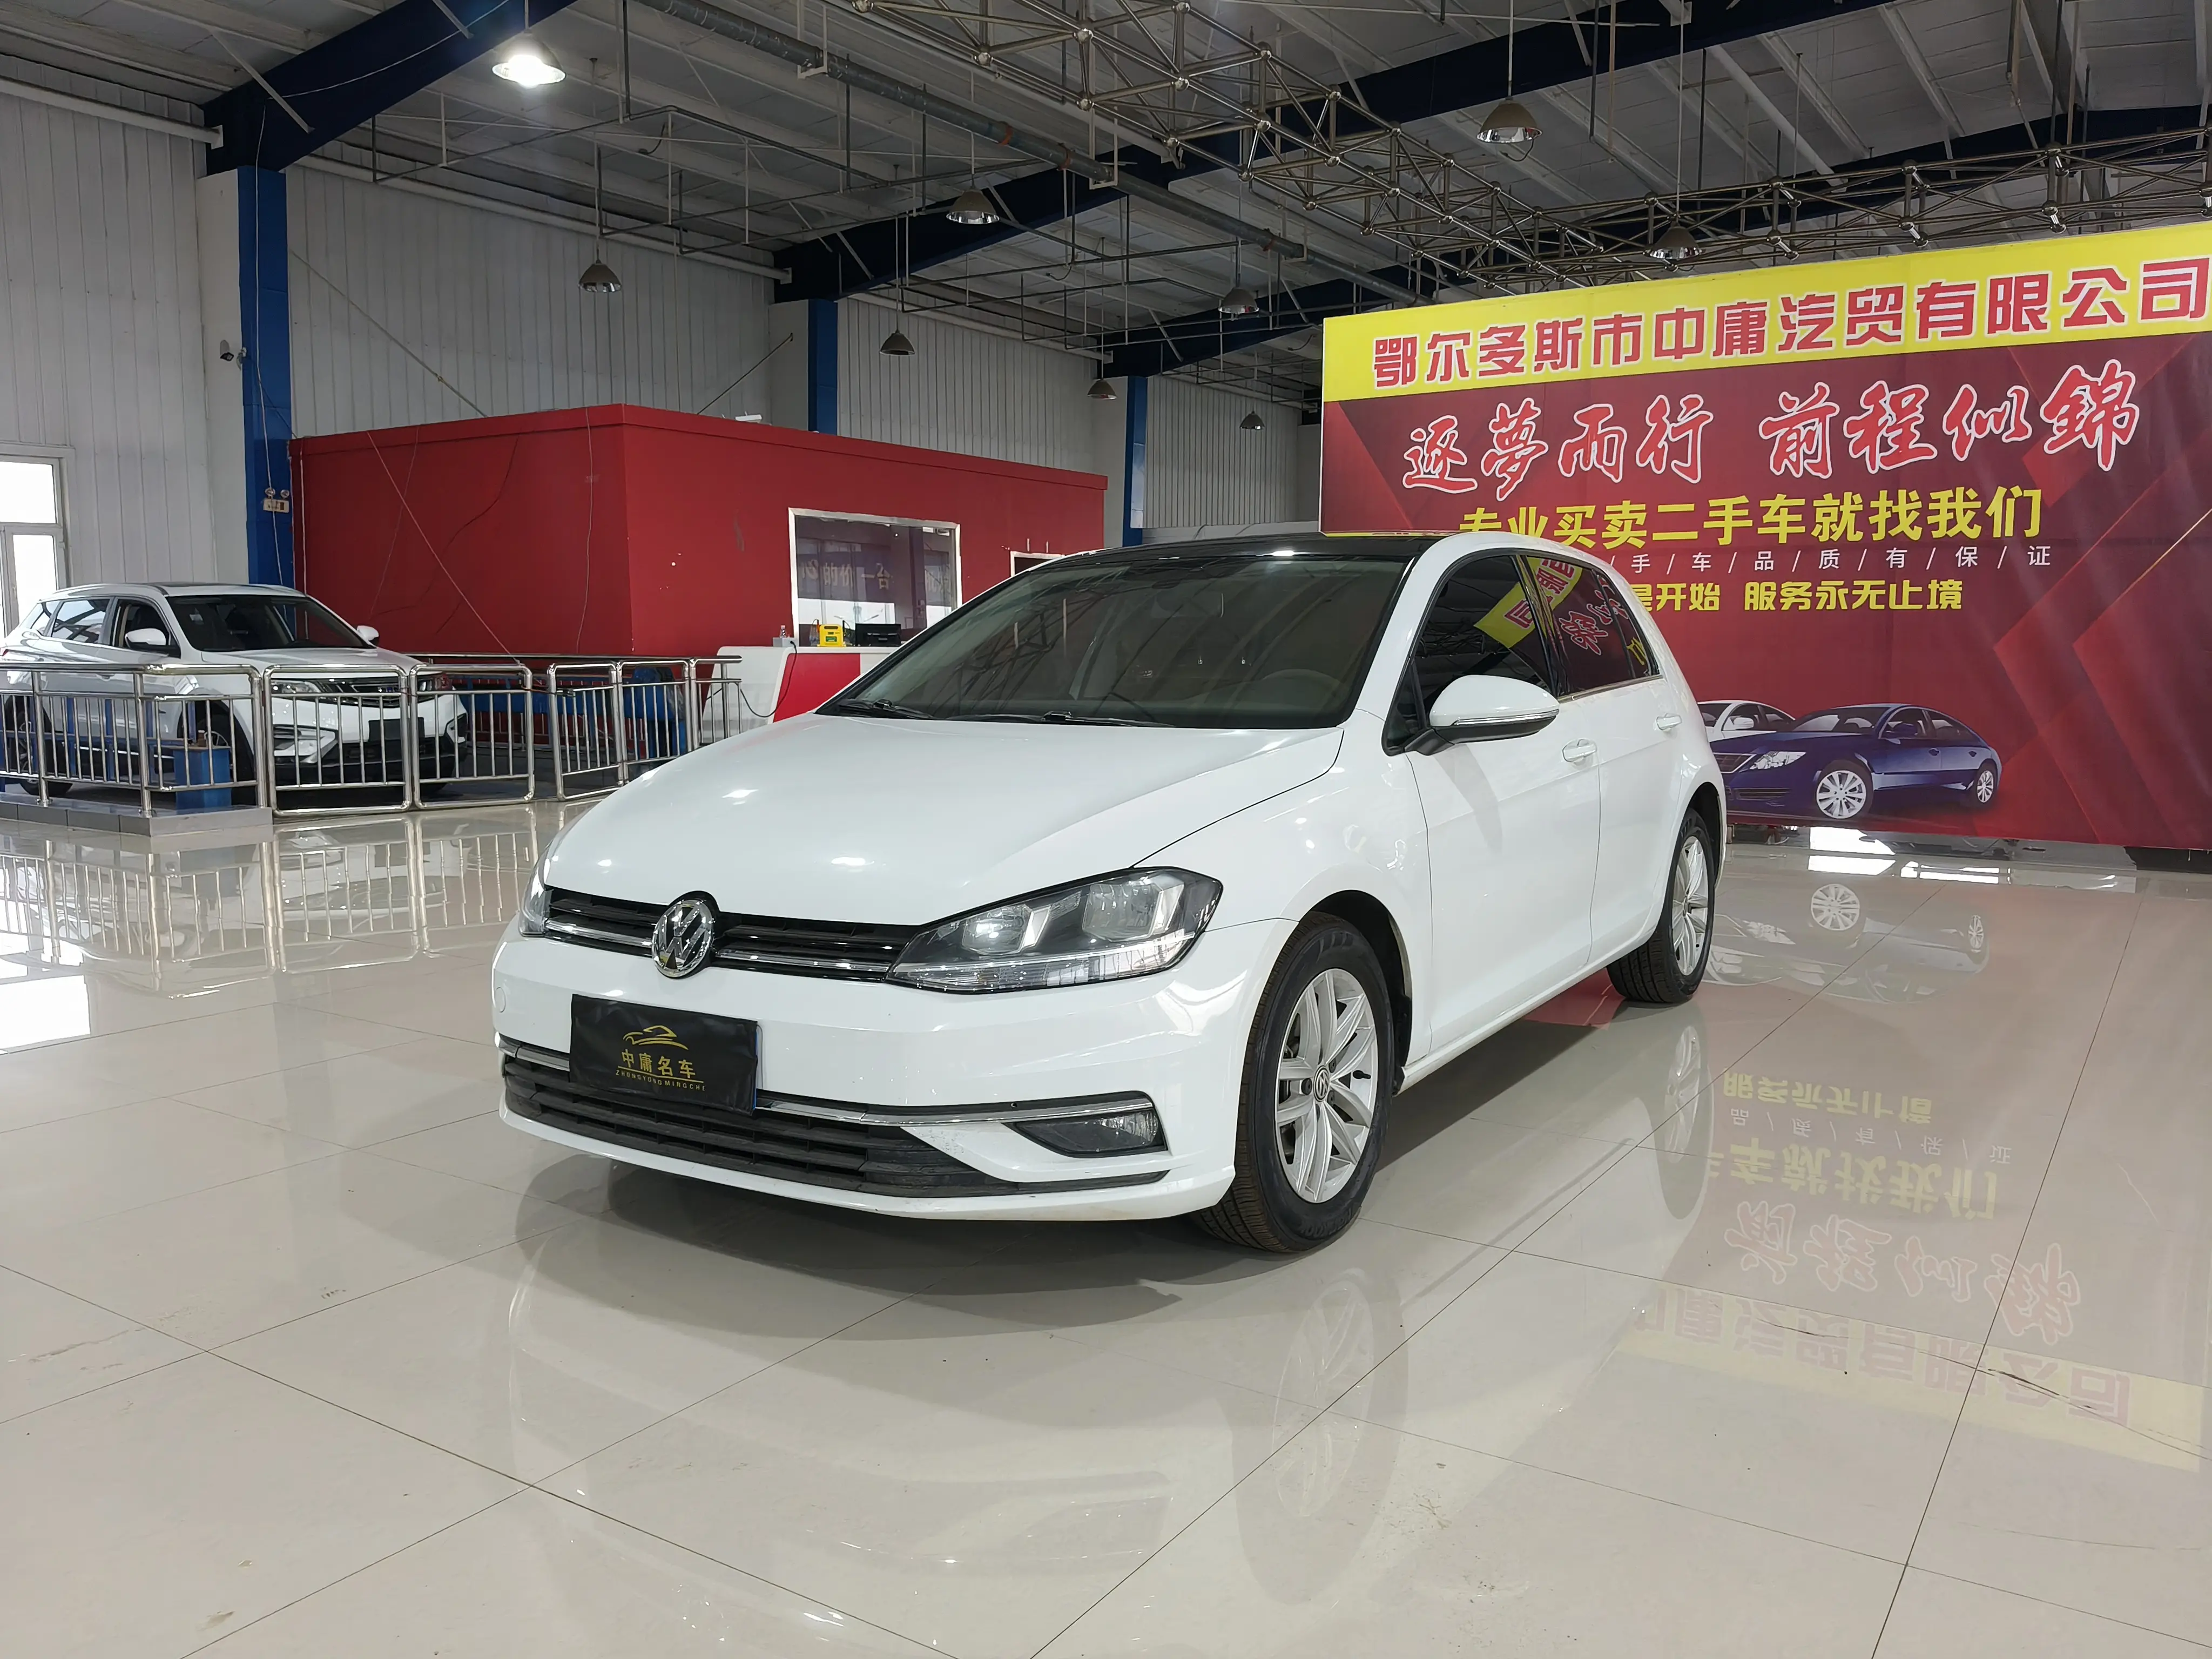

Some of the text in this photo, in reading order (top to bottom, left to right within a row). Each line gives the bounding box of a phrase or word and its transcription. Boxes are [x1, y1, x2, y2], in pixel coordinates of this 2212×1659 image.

[1373, 256, 2212, 388] 鄂尔多斯市中庸汽贸有限公司
[1460, 485, 2042, 549] 专业买卖二手车就找我们
[1744, 579, 1963, 611] 服务永无止境
[622, 1049, 696, 1078] 中庸名车
